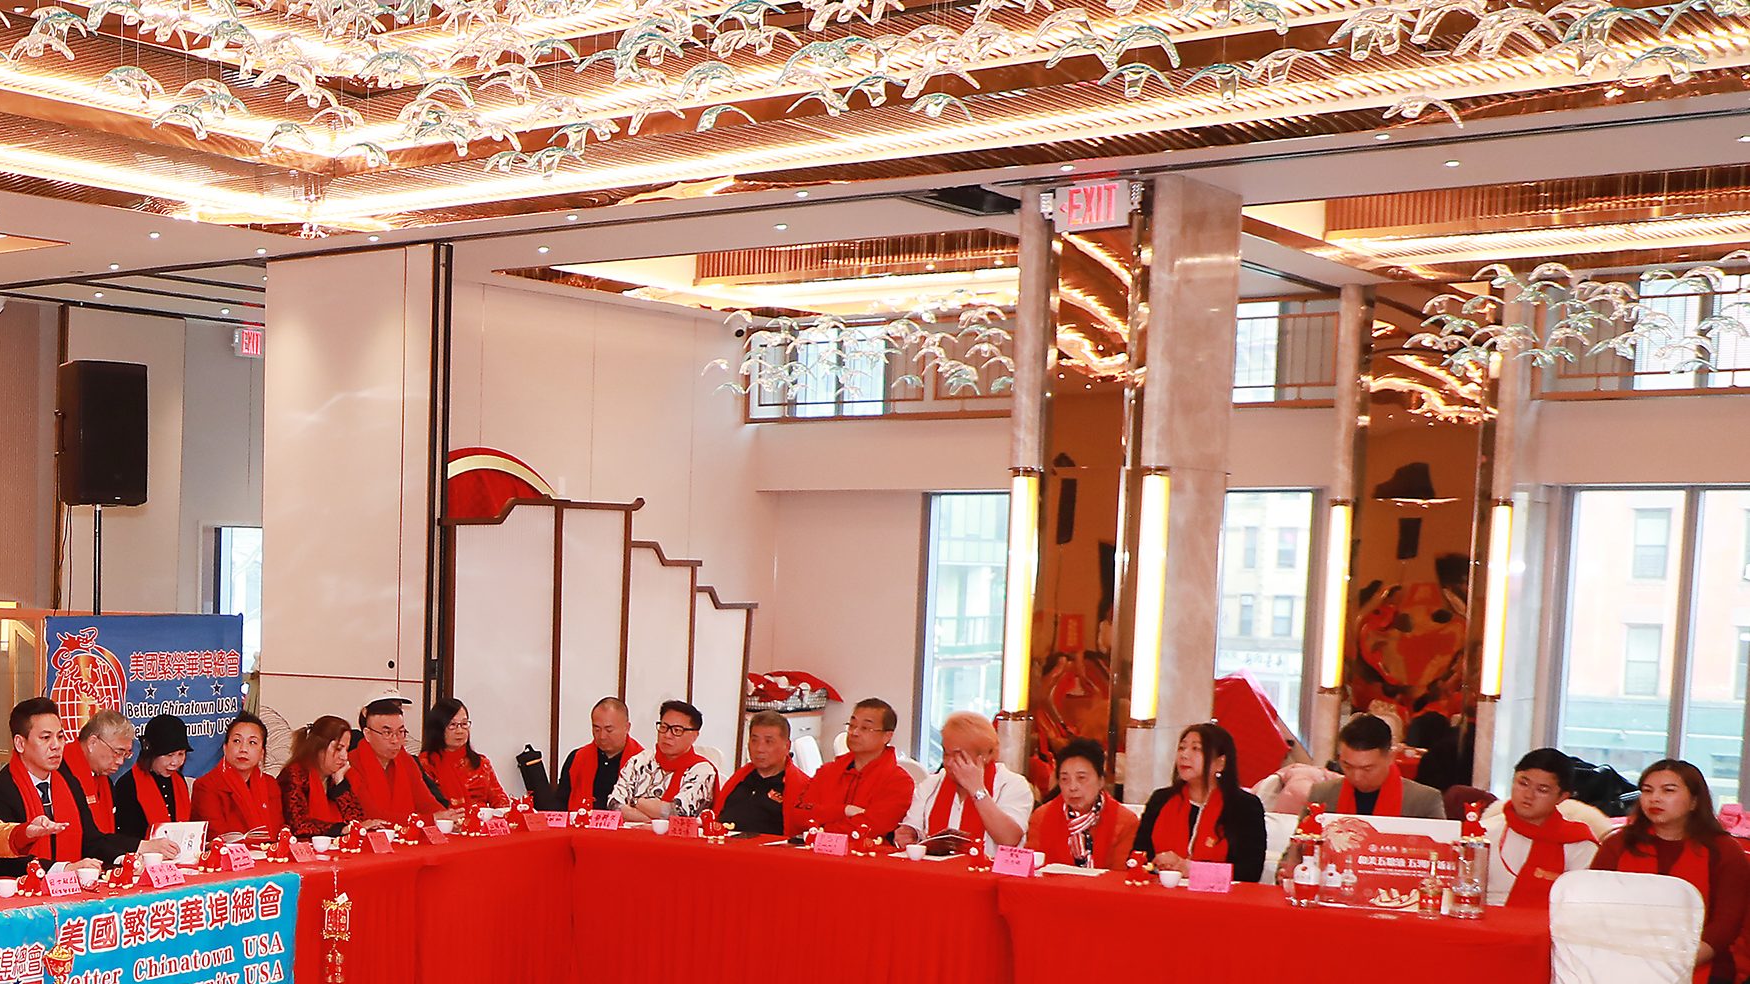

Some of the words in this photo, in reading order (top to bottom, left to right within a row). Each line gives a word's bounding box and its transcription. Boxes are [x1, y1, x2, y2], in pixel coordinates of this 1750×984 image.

[1068, 183, 1119, 225] EXIT
[242, 329, 262, 355] EXIT
[129, 649, 240, 681] 美國繁榮華埠總會
[126, 702, 159, 719] Better
[160, 699, 215, 717] Chinatown
[216, 697, 237, 713] USA
[59, 882, 284, 955] 美國繁榮華埠總會
[132, 943, 234, 983] Chinatown
[243, 931, 284, 958] USA
